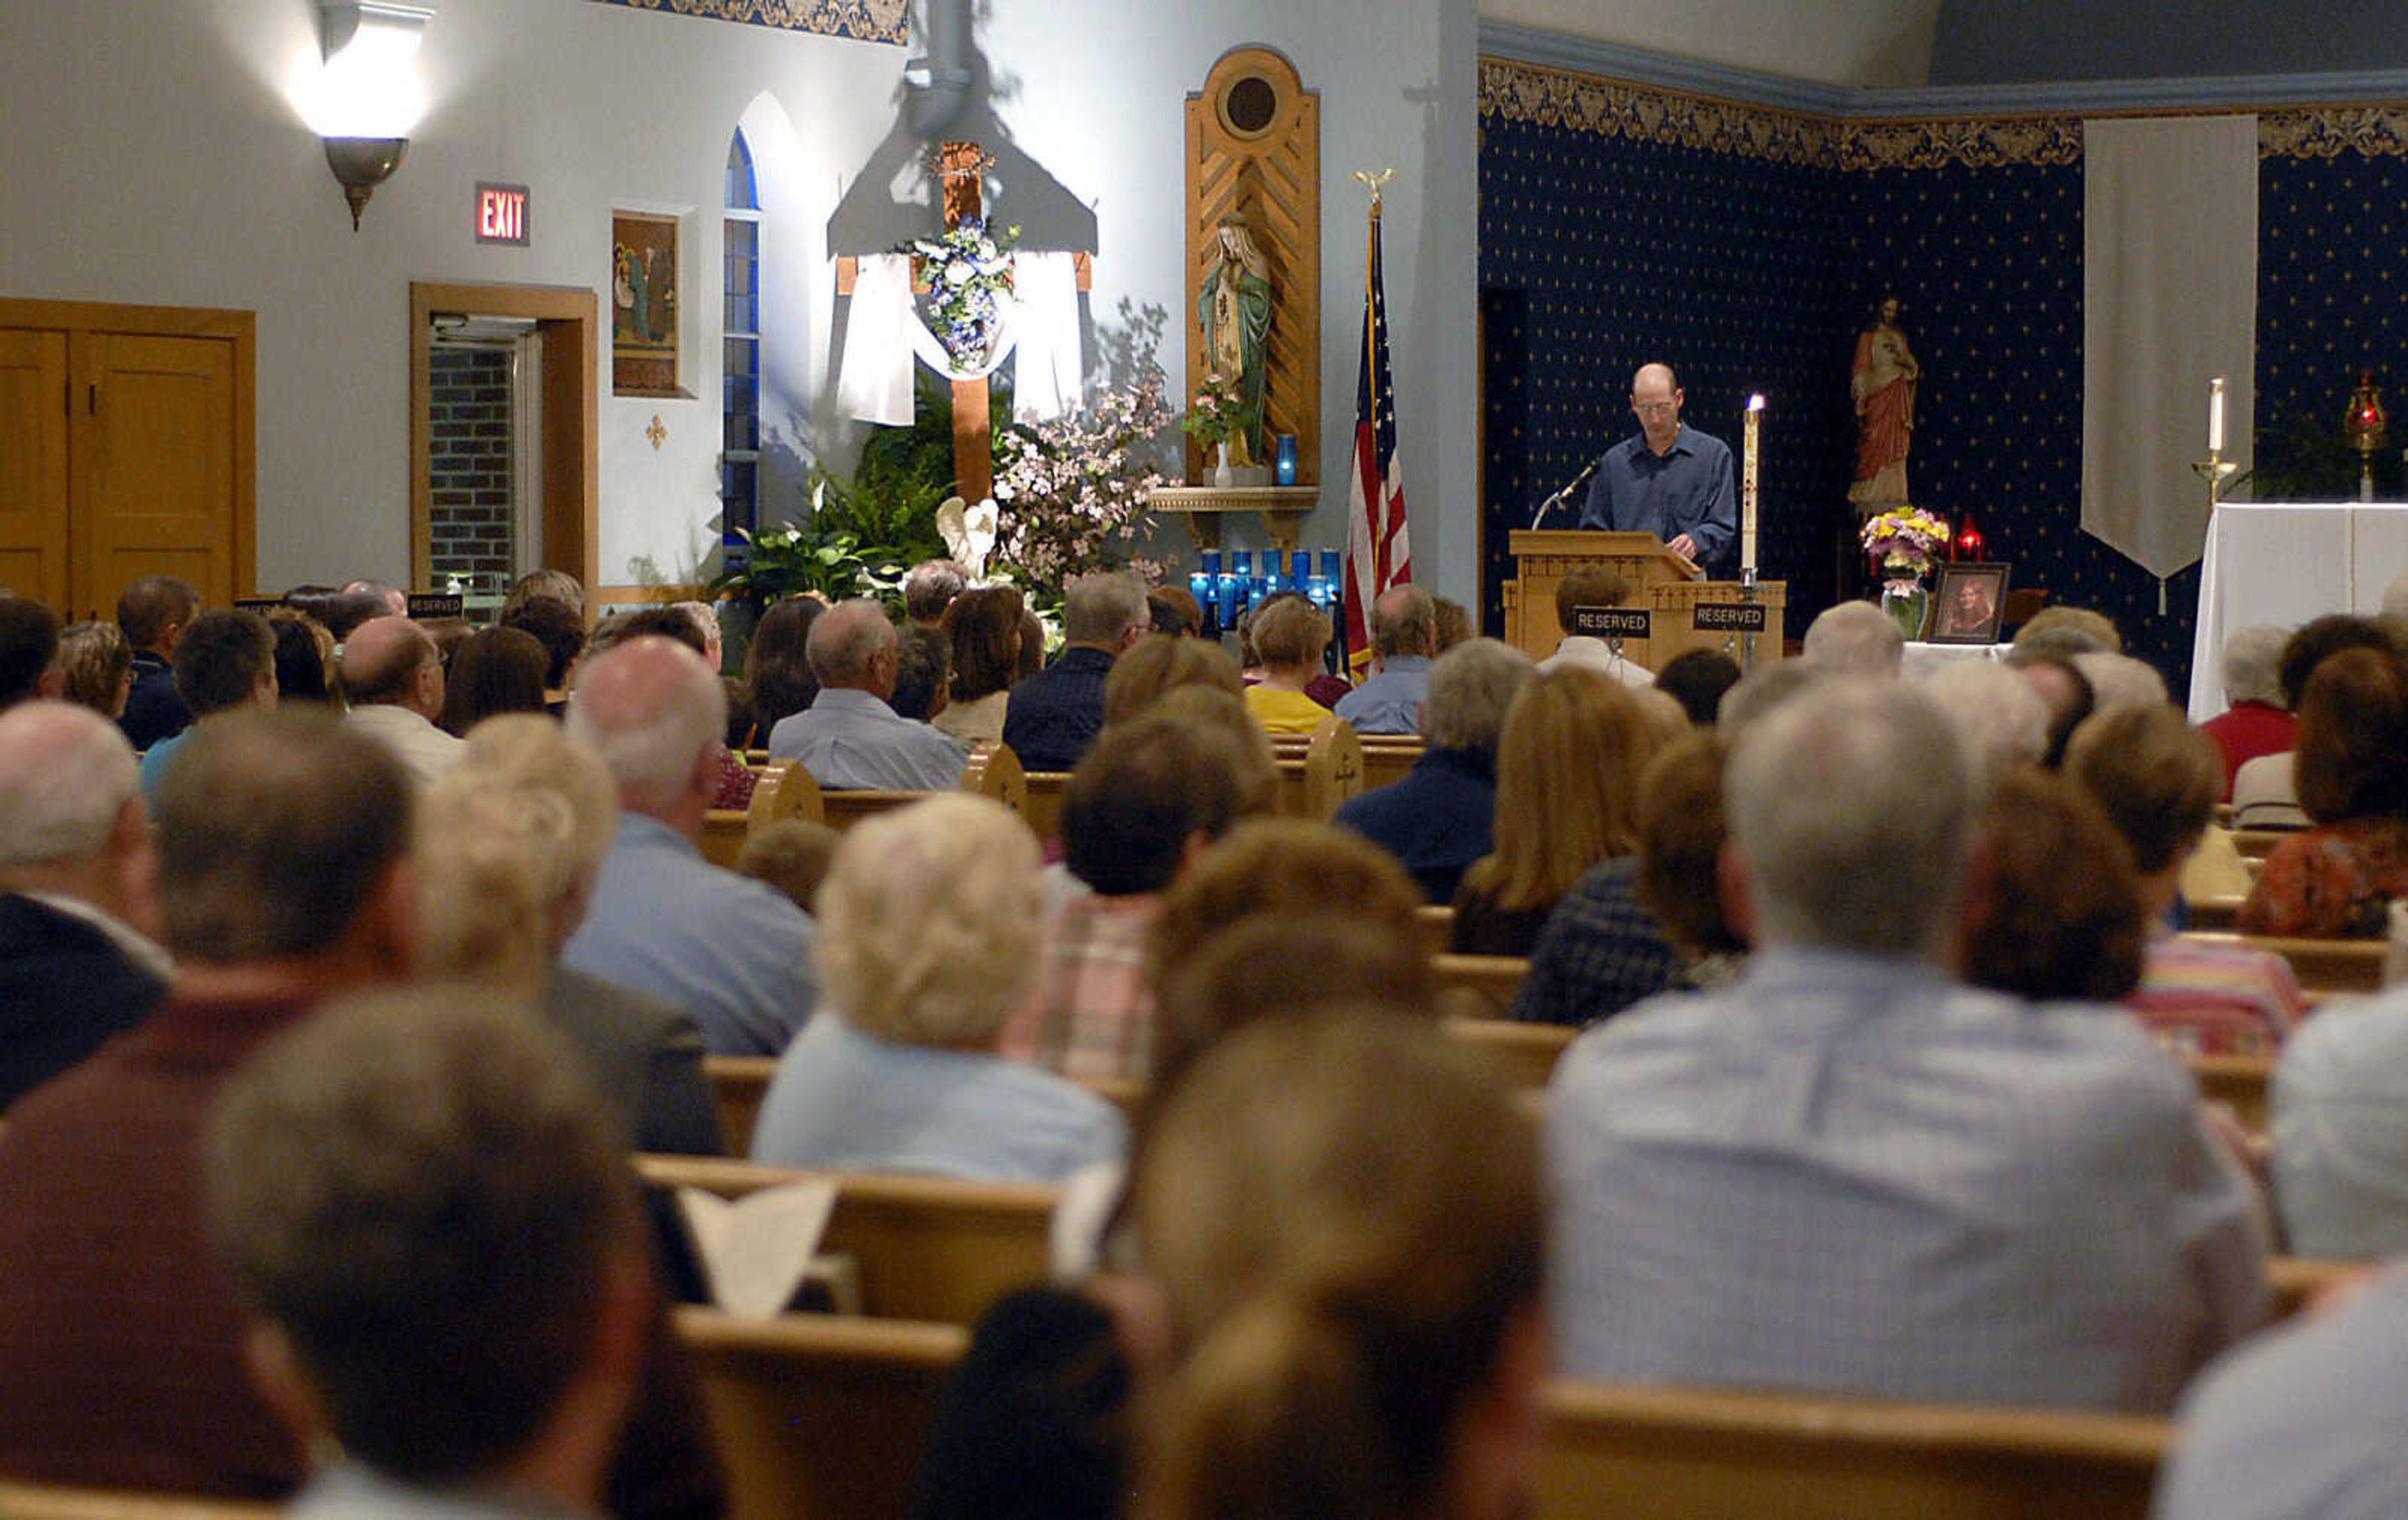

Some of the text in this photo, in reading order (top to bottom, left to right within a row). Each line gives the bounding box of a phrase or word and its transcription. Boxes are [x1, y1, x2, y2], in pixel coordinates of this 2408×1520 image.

[482, 191, 525, 239] EXIT
[1578, 614, 1646, 630] RESERVED
[1698, 608, 1761, 624] RESERVED
